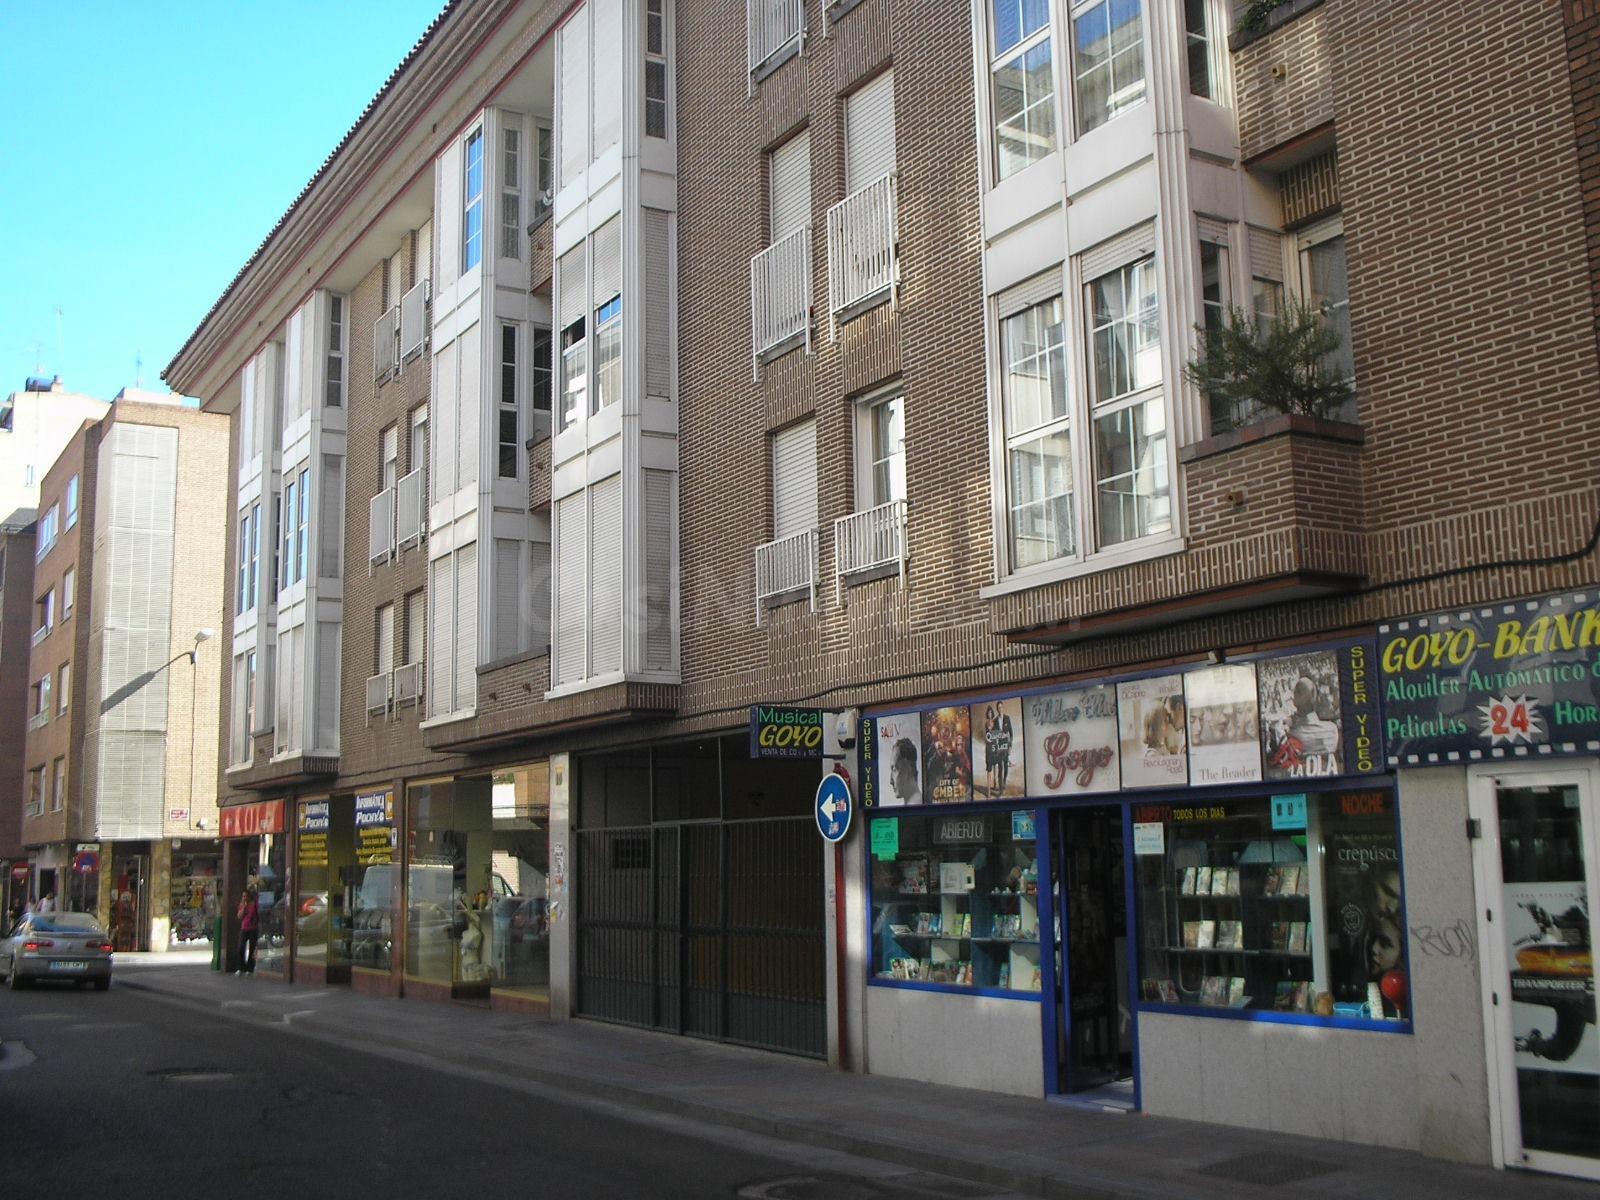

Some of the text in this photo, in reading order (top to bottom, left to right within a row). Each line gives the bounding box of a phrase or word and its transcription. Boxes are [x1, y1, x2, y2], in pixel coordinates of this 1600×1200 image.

[759, 706, 822, 724] Musical
[1350, 646, 1373, 772] SUPER VIDEO
[1490, 703, 1530, 735] 24
[760, 724, 822, 748] GOYO
[863, 719, 874, 807] SUPER VIDEO
[1288, 753, 1339, 778] LA OLA
[1173, 809, 1193, 820] TODOS
[1195, 807, 1207, 818] LOS
[940, 822, 984, 839] ABIERTO
